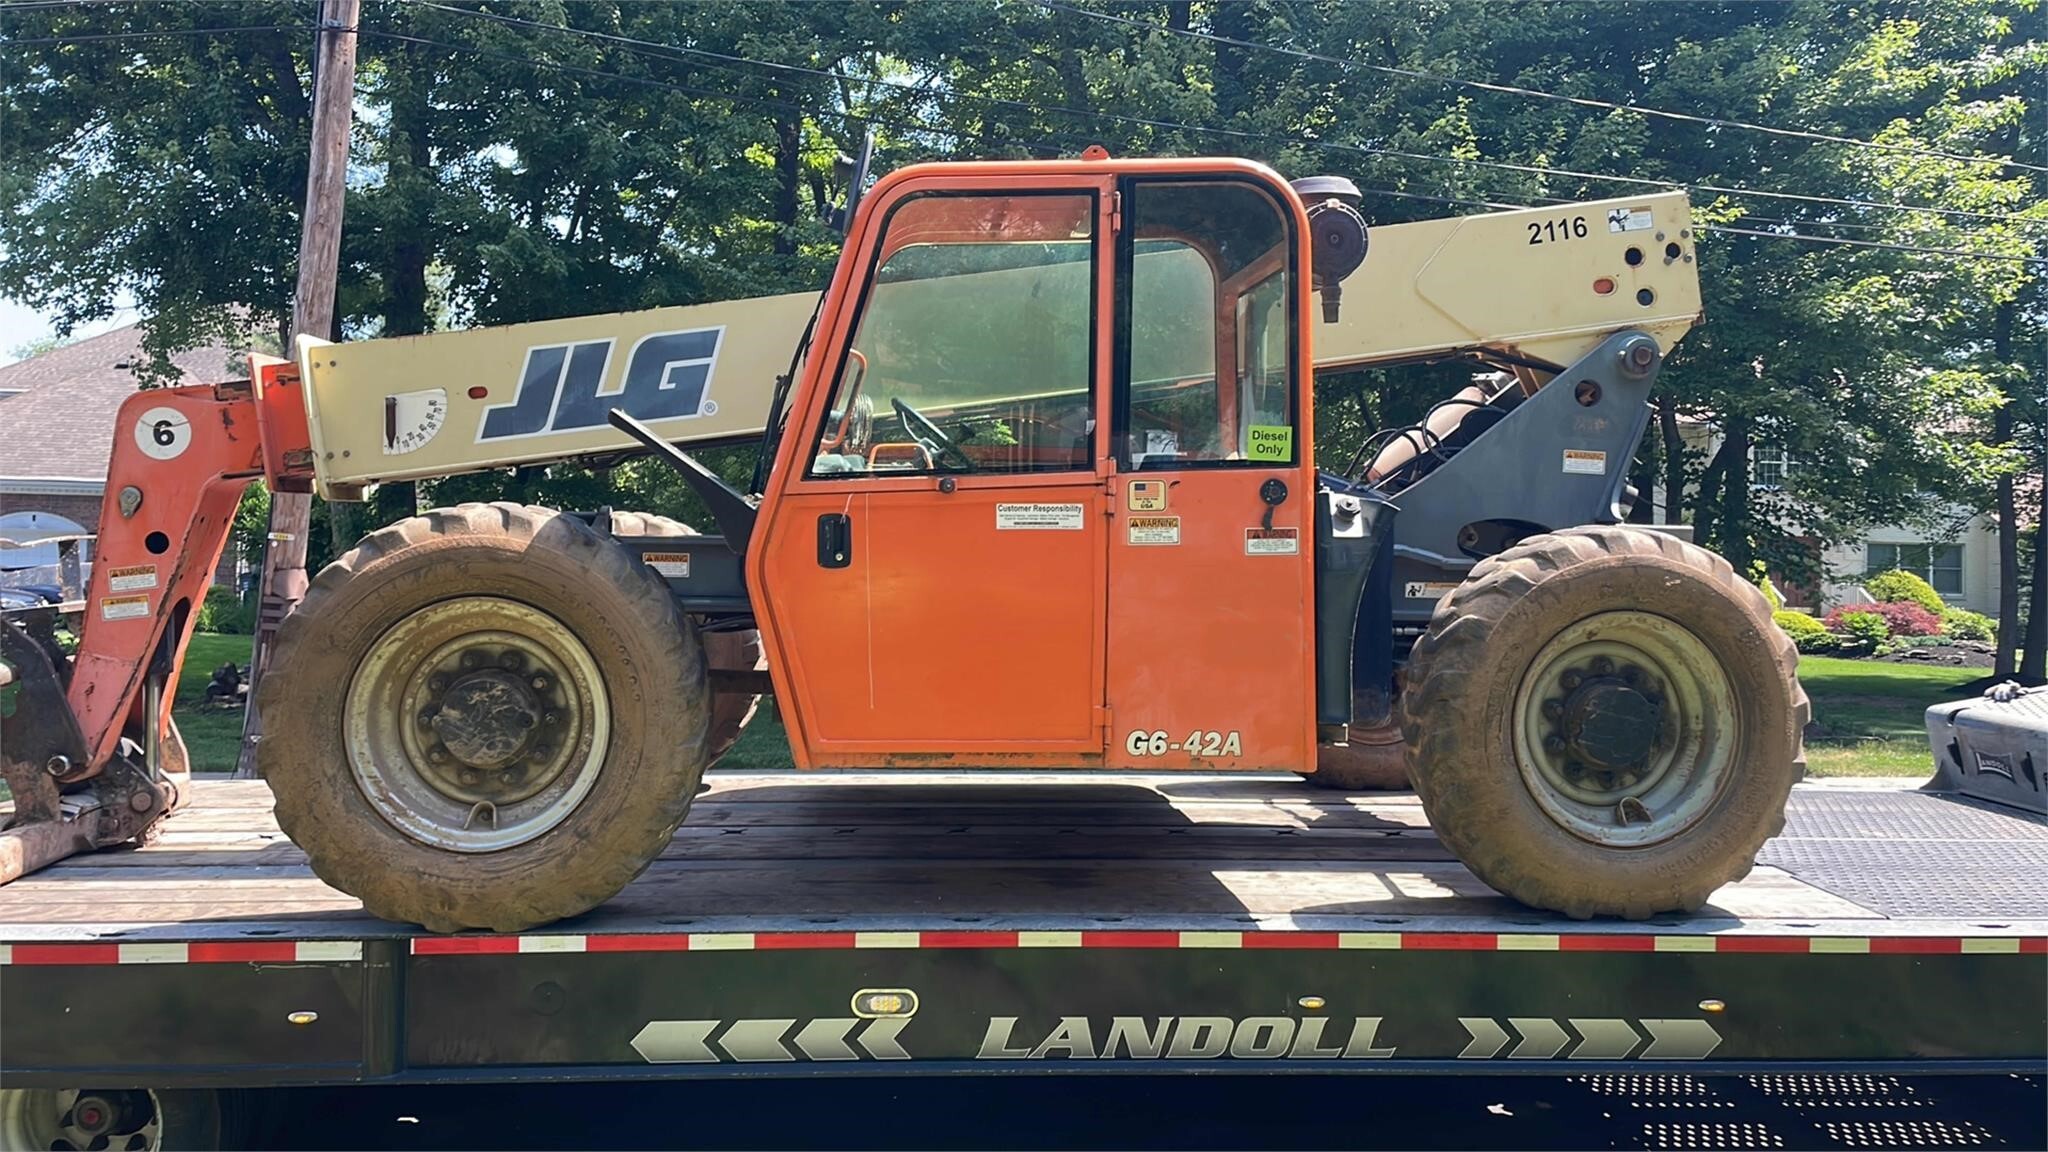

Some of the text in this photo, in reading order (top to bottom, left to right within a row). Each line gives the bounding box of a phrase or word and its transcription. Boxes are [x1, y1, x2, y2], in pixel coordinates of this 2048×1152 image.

[1527, 216, 1588, 245] 2116
[475, 325, 726, 444] JLG
[153, 420, 175, 446] 6
[1252, 430, 1288, 441] Diesel
[1256, 443, 1284, 457] Only
[998, 504, 1082, 514] Customer Responsibility
[1139, 519, 1178, 528] WARNING
[655, 554, 688, 563] WARNING
[118, 566, 155, 576] WARNING
[1126, 729, 1242, 757] G6-42A
[975, 1016, 1398, 1059] LANDOLL
